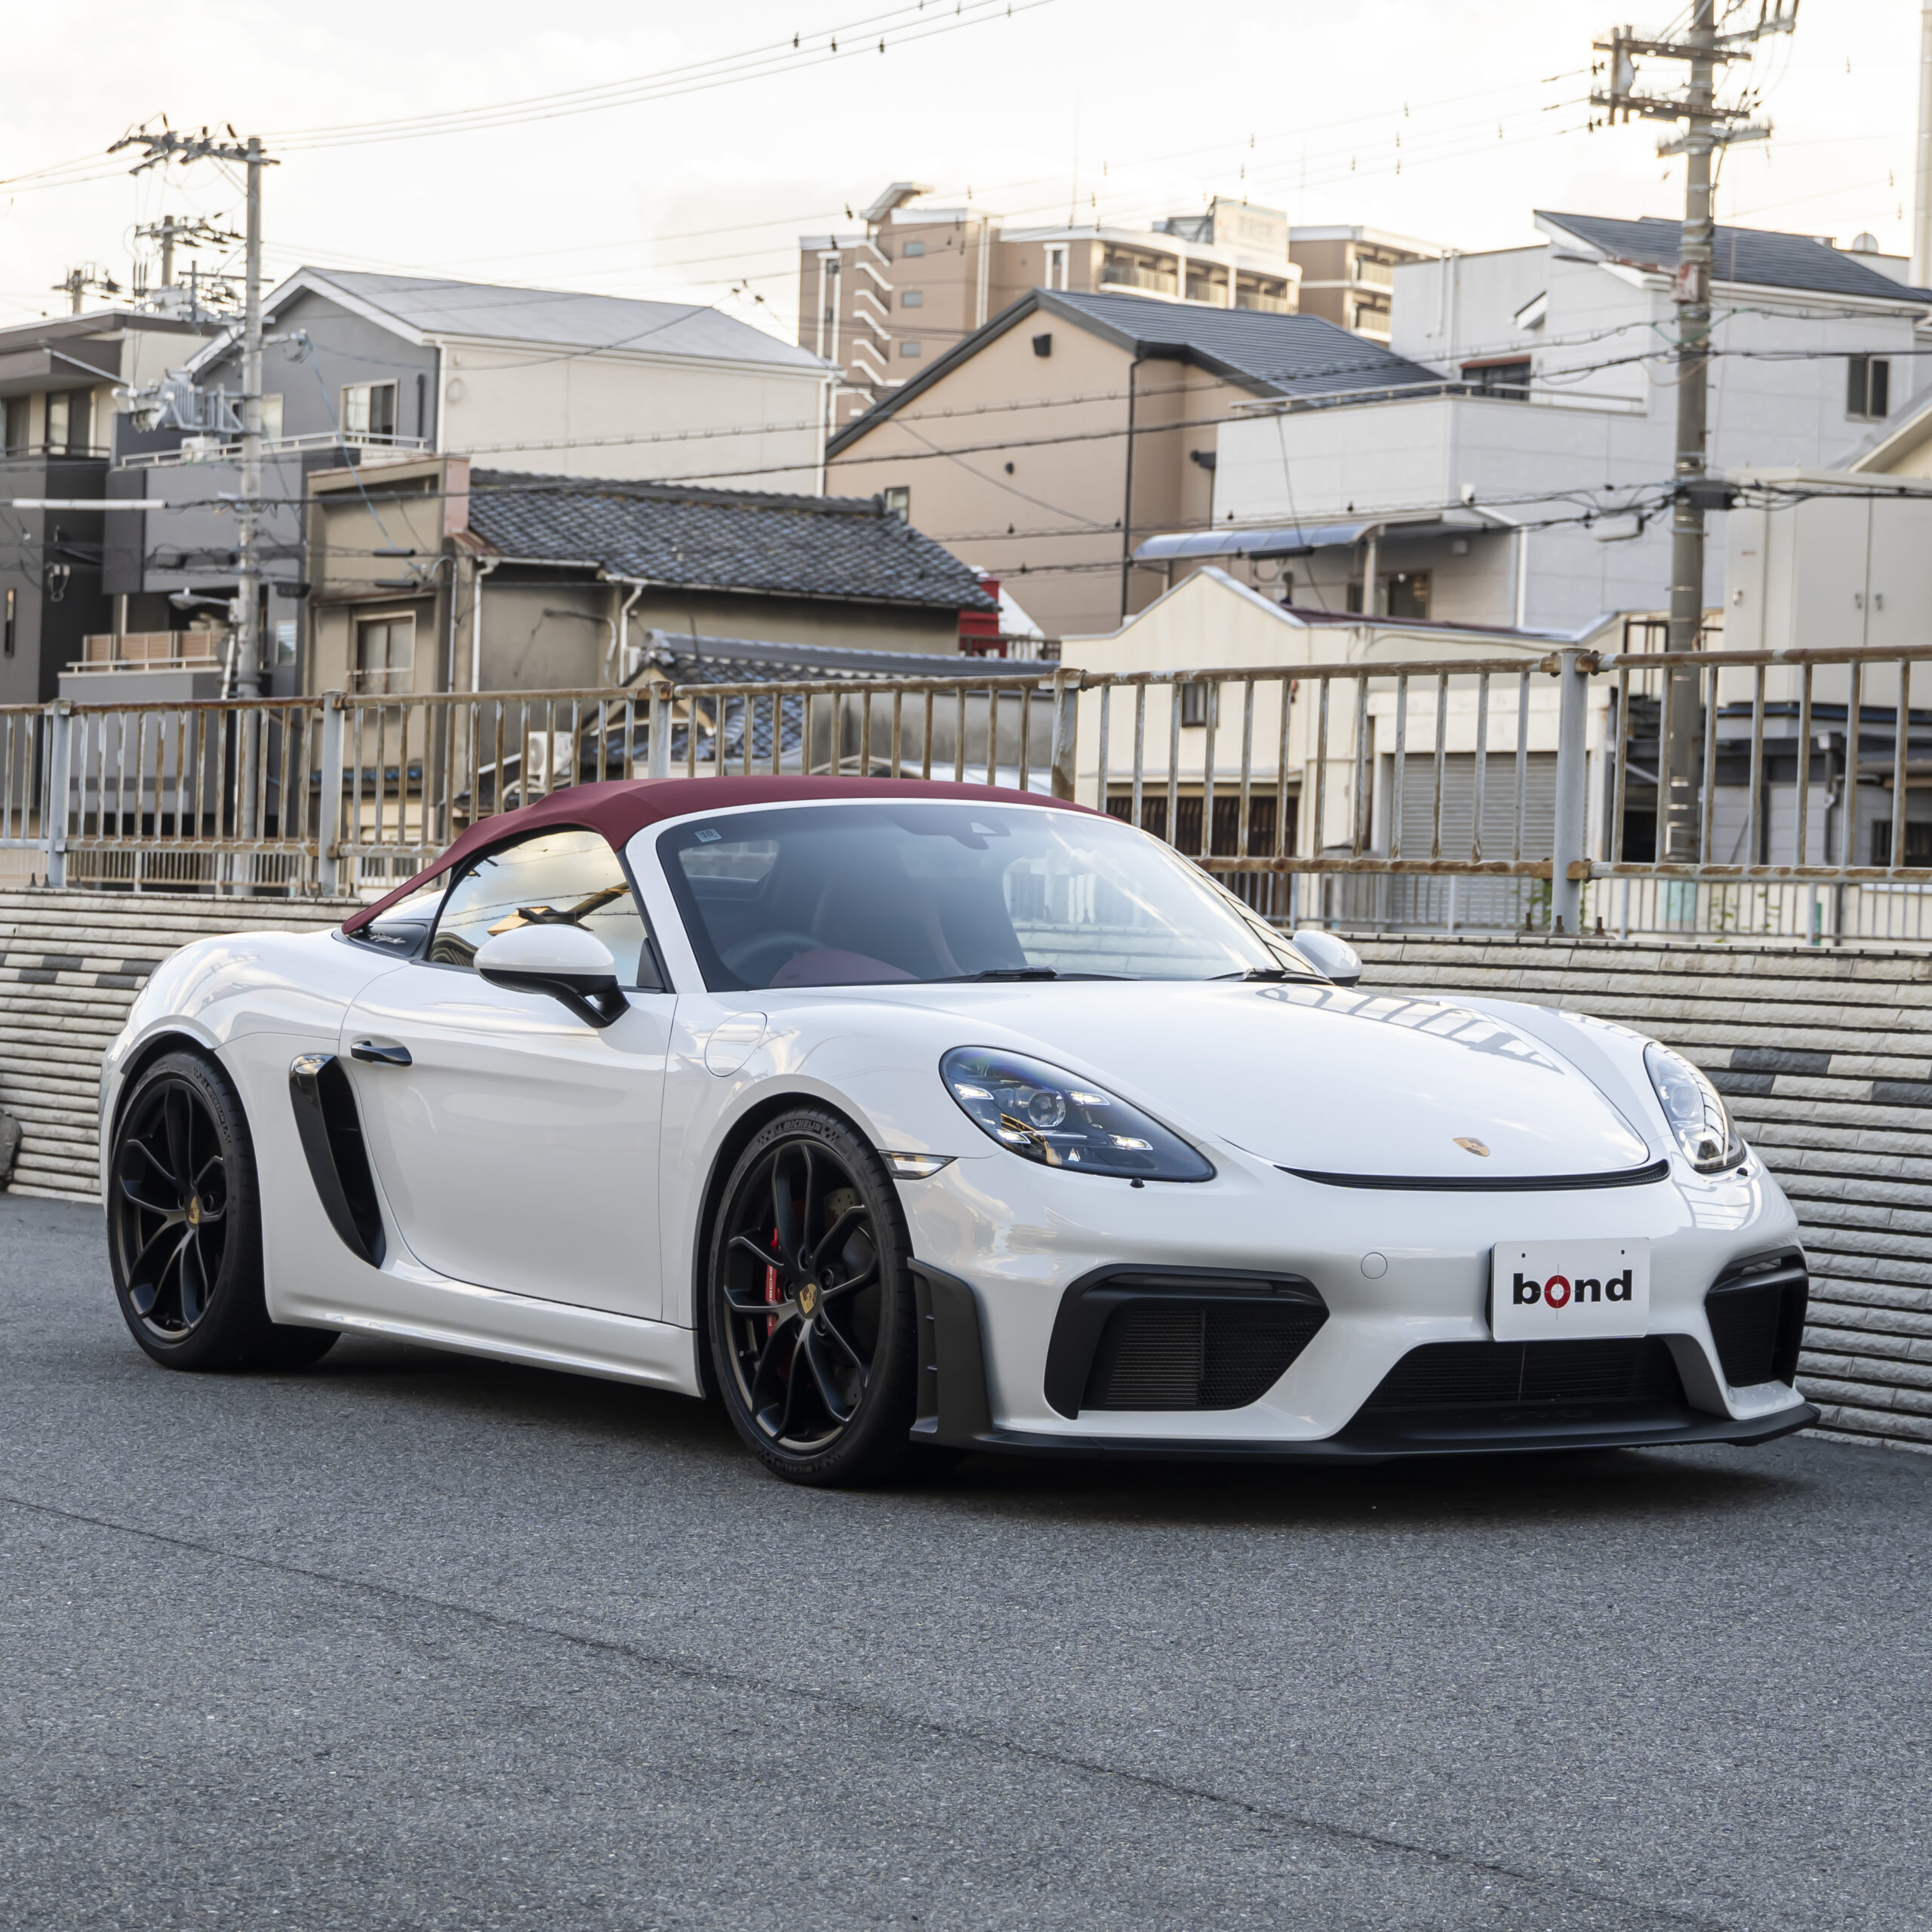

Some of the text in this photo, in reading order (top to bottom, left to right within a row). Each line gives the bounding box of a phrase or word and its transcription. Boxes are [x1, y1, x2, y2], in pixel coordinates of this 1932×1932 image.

[206, 1085, 226, 1123] MICHELIN
[783, 1119, 822, 1132] MICHELIN
[1512, 1269, 1632, 1309] bond
